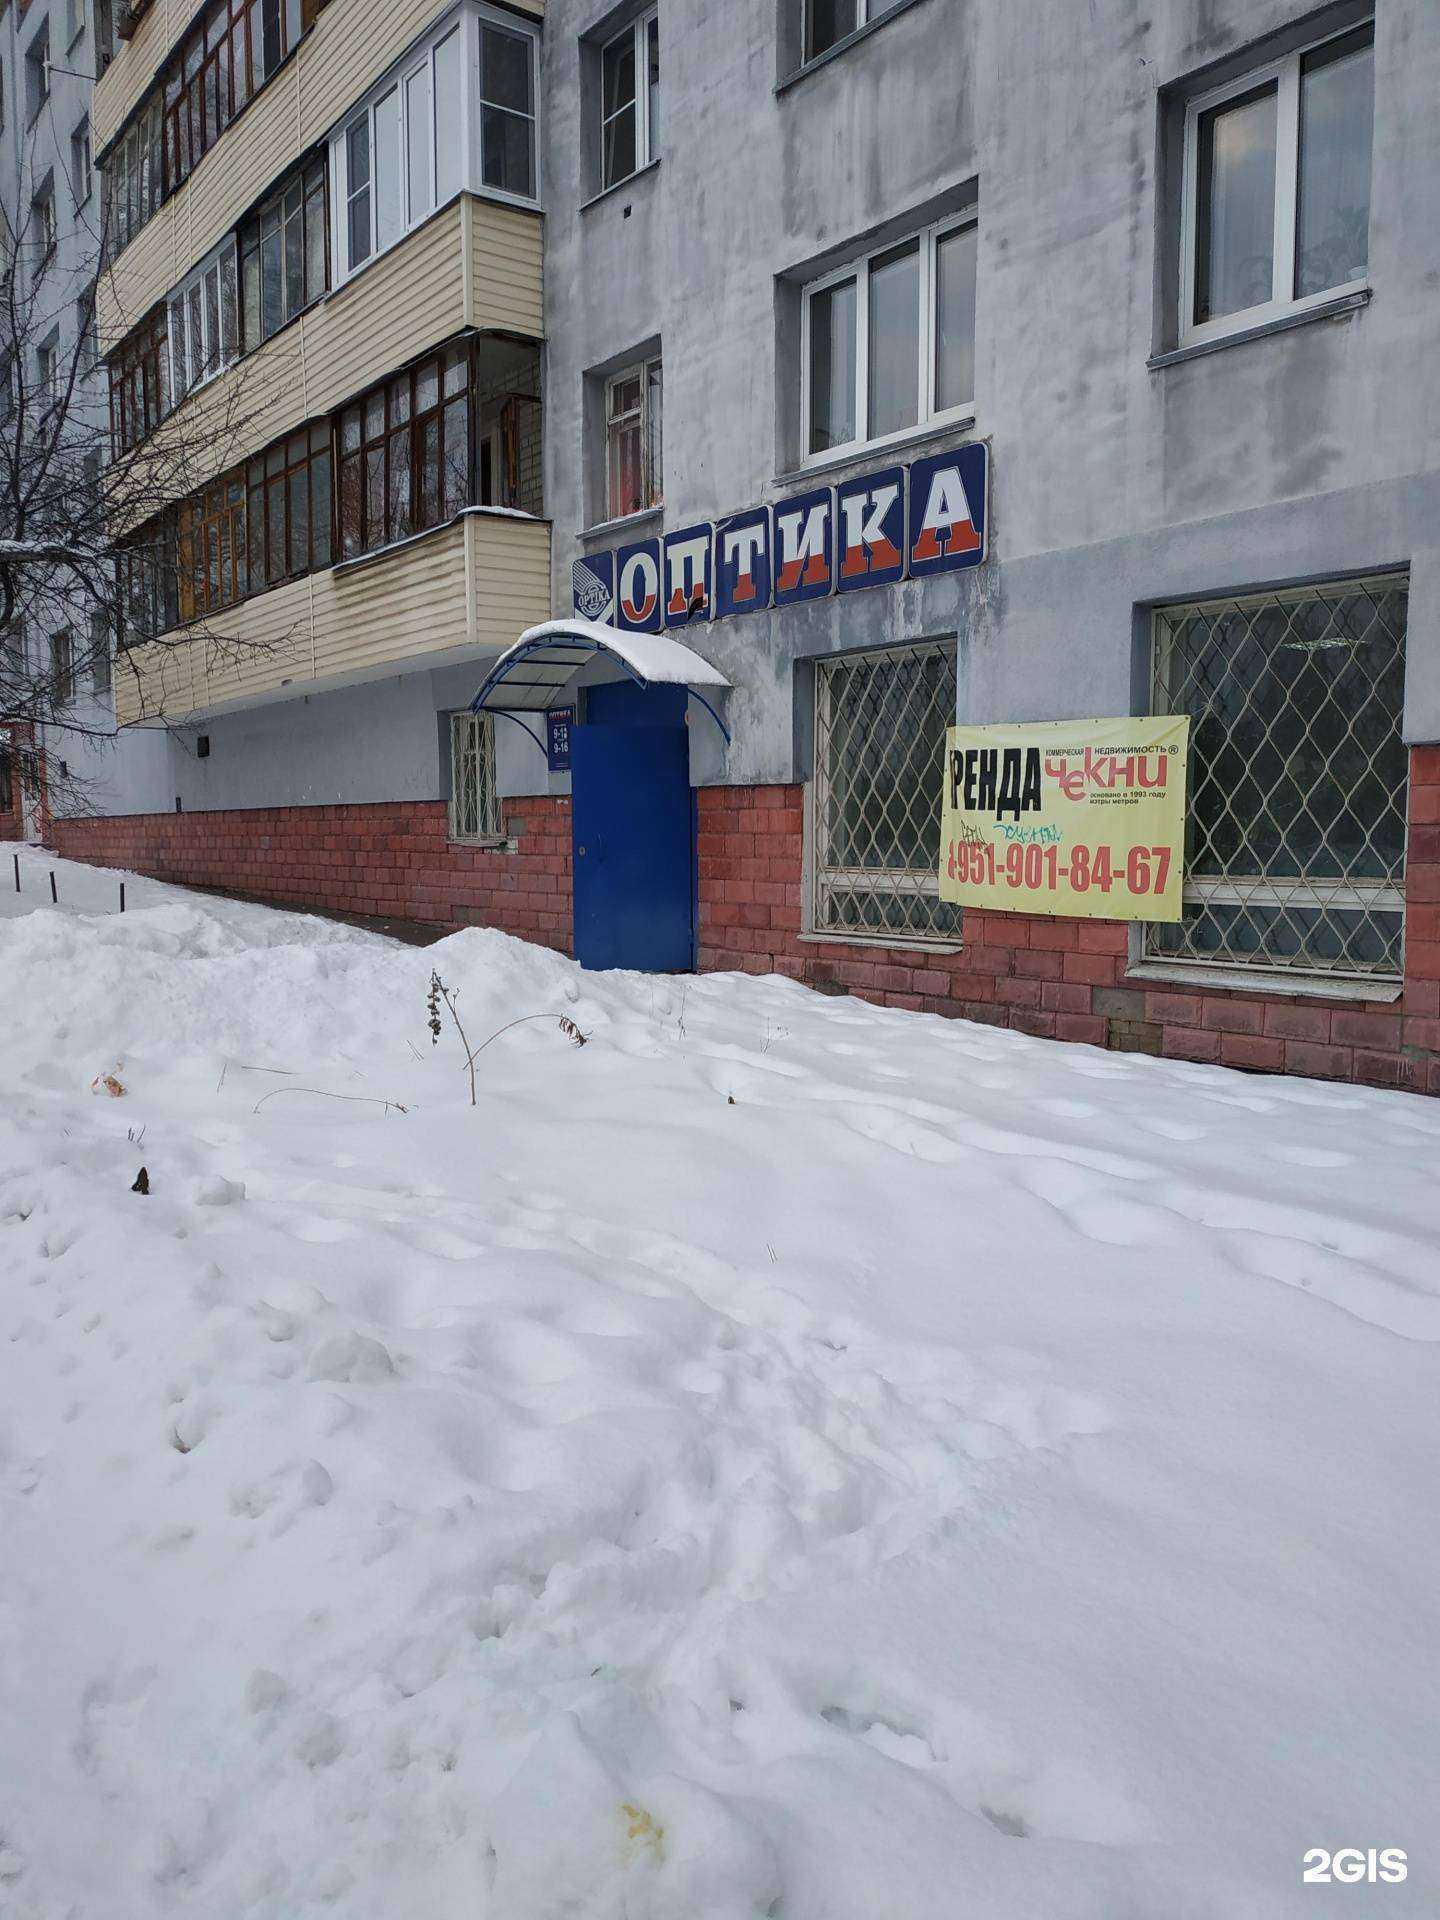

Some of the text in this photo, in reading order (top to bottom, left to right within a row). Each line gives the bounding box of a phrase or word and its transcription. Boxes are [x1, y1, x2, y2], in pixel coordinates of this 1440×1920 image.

[620, 466, 981, 623] ОПТИКА
[553, 742, 569, 754] 9-16
[1094, 745, 1167, 755] НЕДВИЖИМОСТЬ
[950, 747, 1042, 821] РЕНДА
[1149, 791, 1166, 799] году
